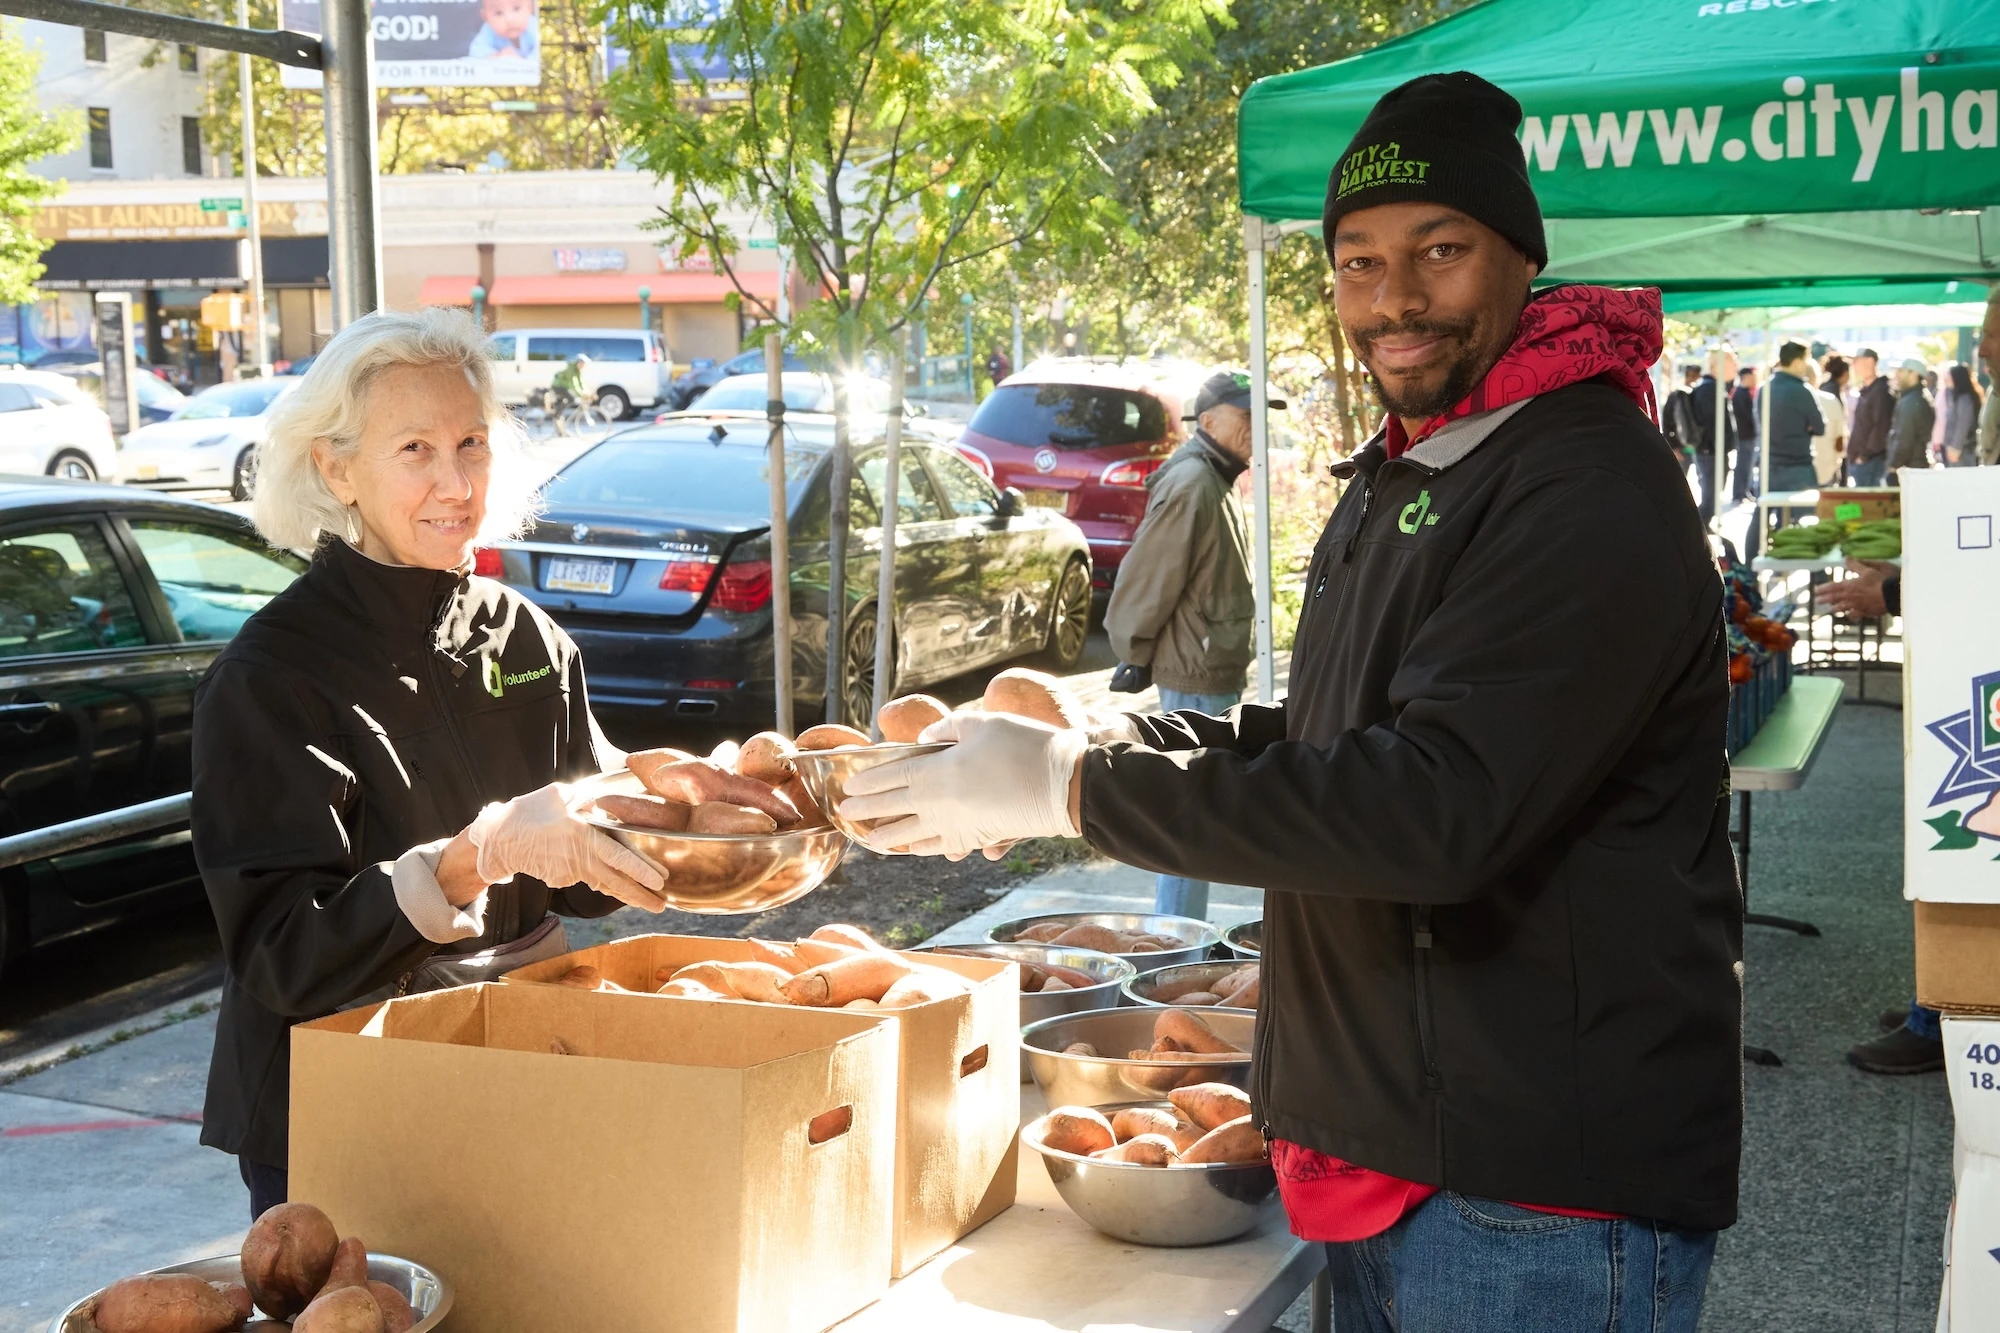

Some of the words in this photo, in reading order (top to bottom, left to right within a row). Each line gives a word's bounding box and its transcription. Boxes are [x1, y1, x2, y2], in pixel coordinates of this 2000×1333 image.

[1698, 0, 1837, 17] RESC
[371, 15, 439, 41] GOD!
[1342, 144, 1380, 176] CITY
[1337, 160, 1430, 196] HARVEST
[1366, 179, 1388, 188] FOOD
[502, 665, 551, 686] Volunteer
[1966, 1043, 2000, 1065] 40
